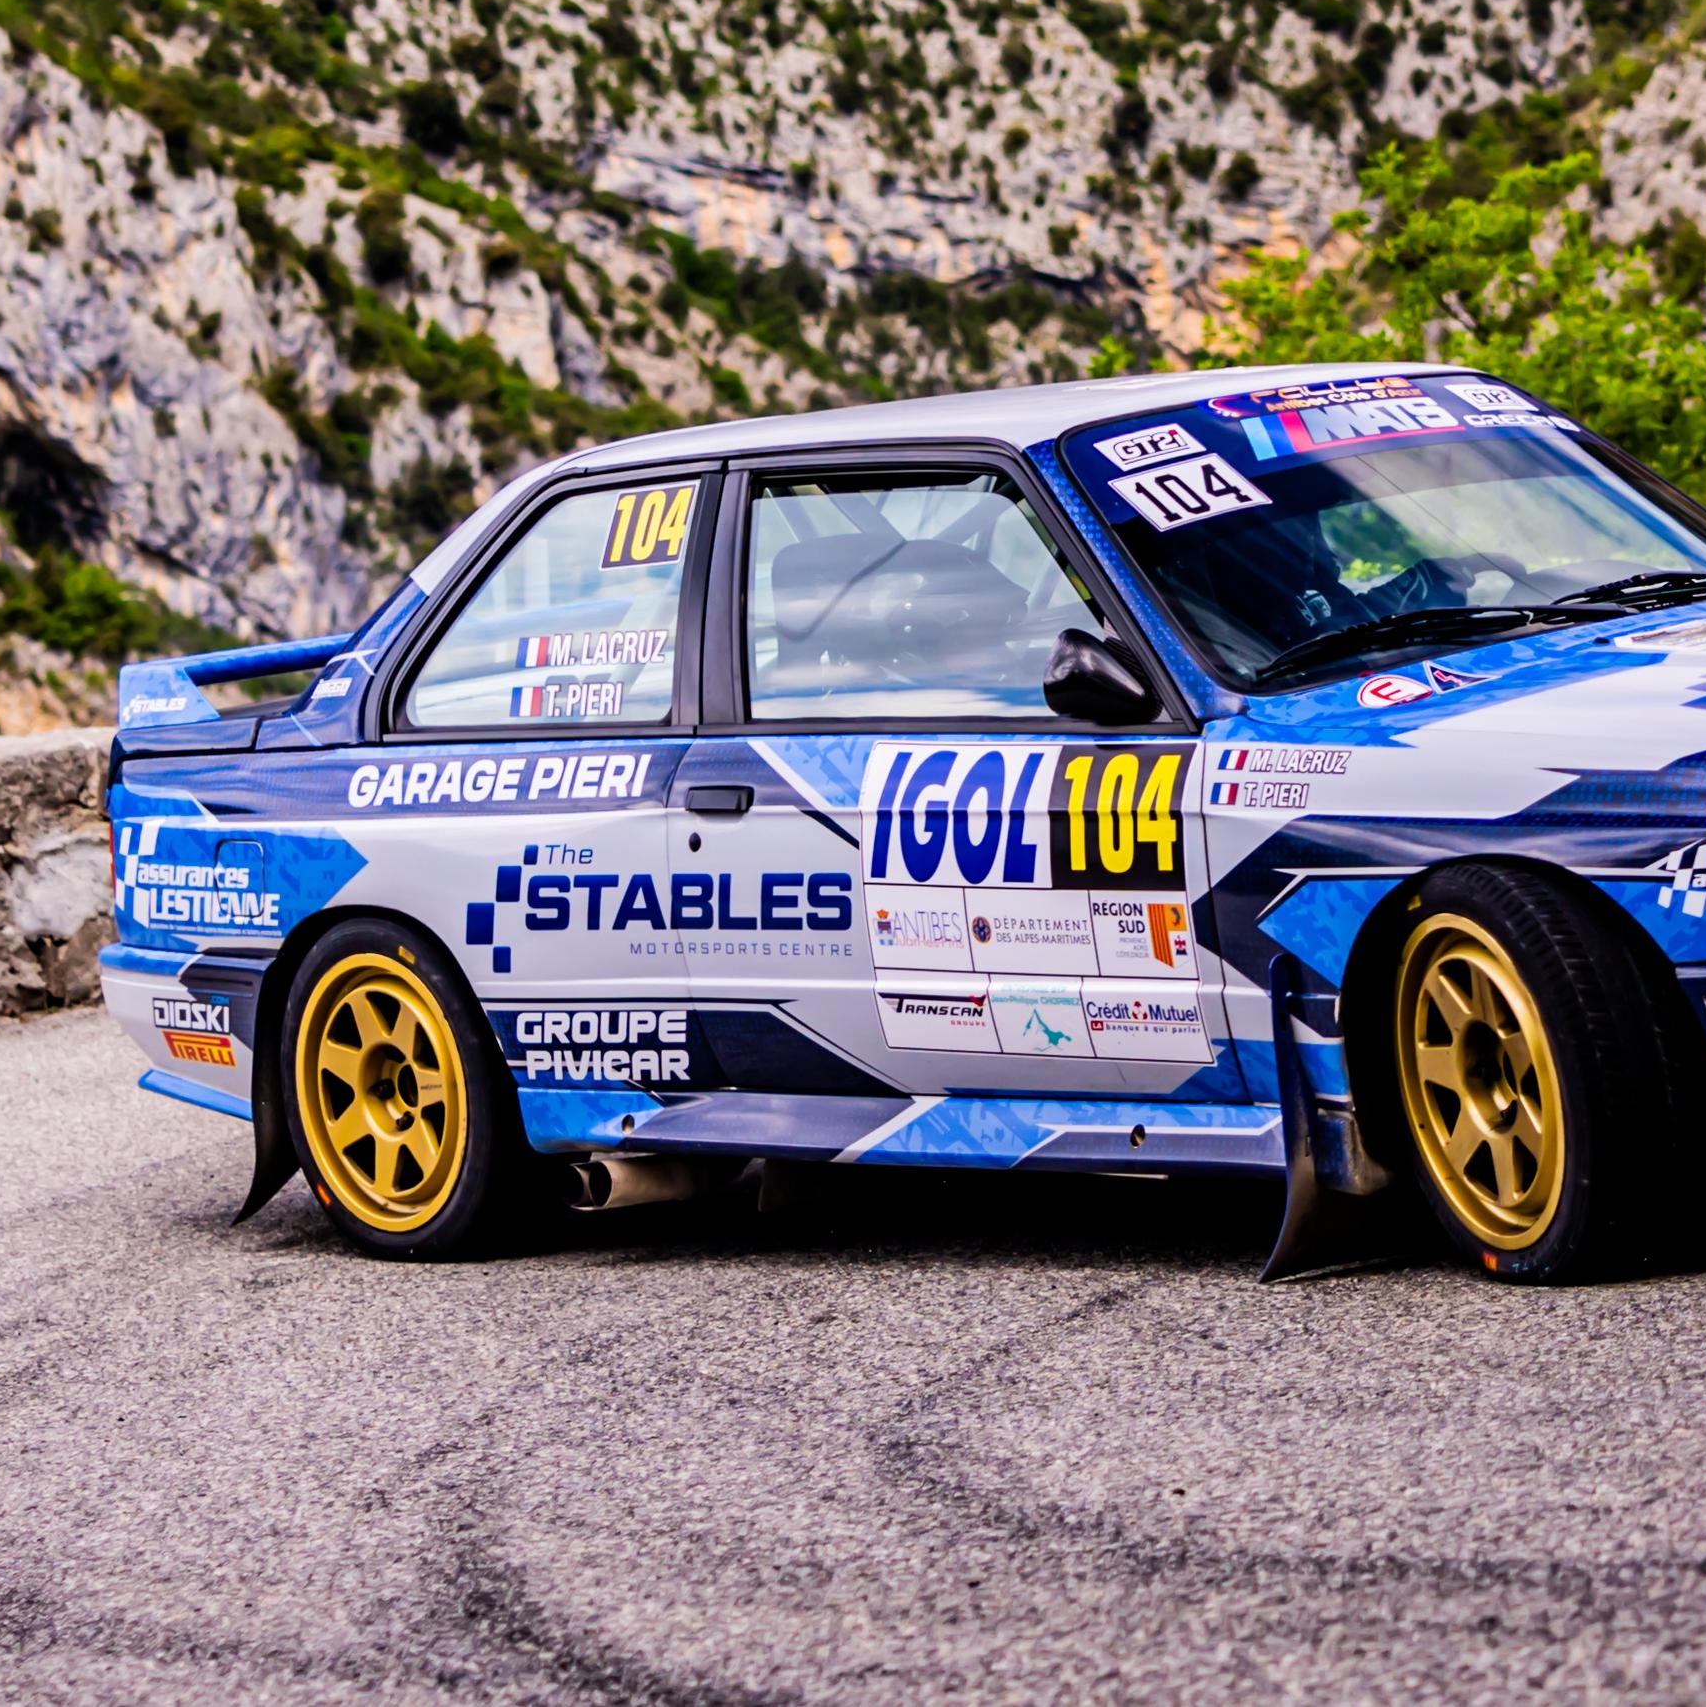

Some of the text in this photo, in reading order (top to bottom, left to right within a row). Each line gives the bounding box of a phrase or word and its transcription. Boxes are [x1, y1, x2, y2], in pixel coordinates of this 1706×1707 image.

[1299, 396, 1459, 444] MATS
[1462, 414, 1556, 428] ORECA
[1113, 429, 1188, 462] GT2i
[1134, 463, 1253, 522] 104
[609, 487, 693, 563] 104
[549, 629, 669, 666] M. LACRUZ
[544, 682, 624, 717] T. PIERI
[1249, 749, 1351, 774] M. LACRUZ
[348, 754, 652, 808] GARAGE PIERI
[1244, 782, 1310, 808] T. PIERI
[870, 750, 1045, 885] IGOL
[1065, 753, 1182, 874] 104
[544, 844, 593, 865] The
[138, 861, 250, 889] assurances
[149, 888, 281, 927] LESTIENNE
[525, 872, 853, 931] STABLES
[1092, 899, 1143, 917] RÉGION
[893, 911, 963, 943] ANTIBES
[993, 916, 1089, 931] DÉPARTEMENT
[996, 933, 1092, 945] DES ALPES-MARITIMES
[1118, 920, 1146, 934] SUD
[629, 941, 854, 957] MOTORSPORTS CENTRE
[154, 999, 230, 1033] DIOSKI
[516, 1010, 687, 1044] GROUPE
[1086, 1001, 1199, 1022] Crédit Mutuel
[1092, 1021, 1103, 1030] LA
[1106, 1023, 1139, 1032] banque
[1172, 1026, 1201, 1034] parler
[162, 1030, 237, 1067] PIRELLI
[525, 1049, 691, 1081] PIVICAR
